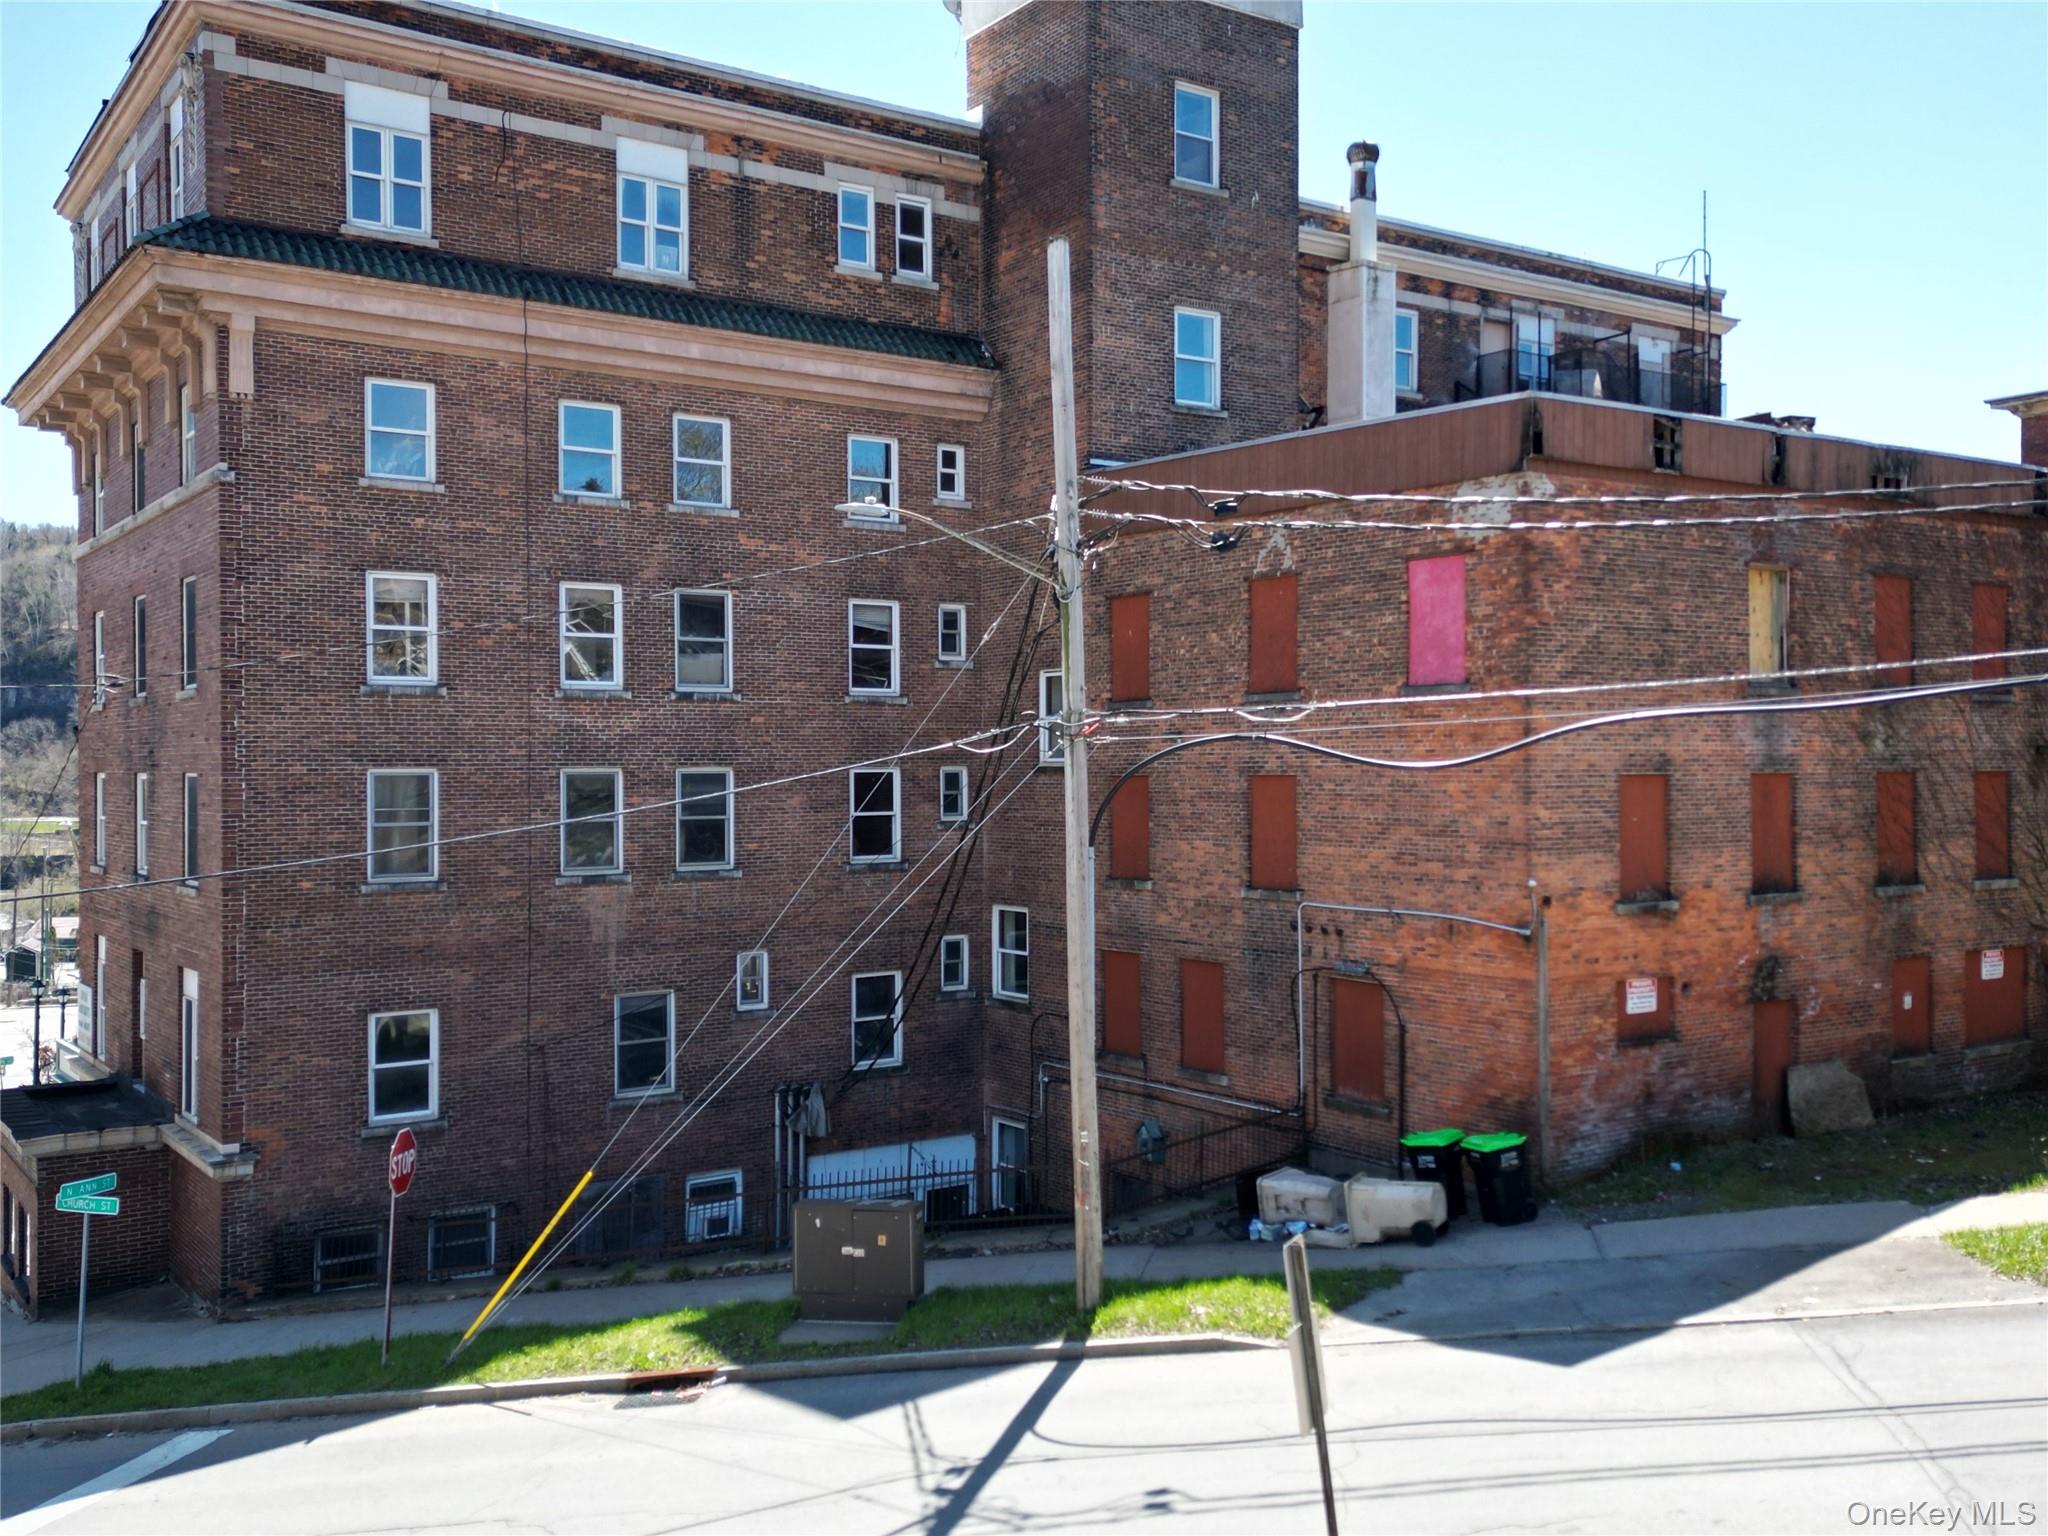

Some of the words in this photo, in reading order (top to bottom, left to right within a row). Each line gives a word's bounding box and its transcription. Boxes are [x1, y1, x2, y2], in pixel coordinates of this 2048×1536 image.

[391, 1149, 415, 1180] STOP
[66, 1187, 73, 1196] N
[79, 1183, 97, 1193] ANN
[102, 1178, 111, 1189] ST
[62, 1199, 96, 1210] CHURCH
[101, 1200, 112, 1211] ST
